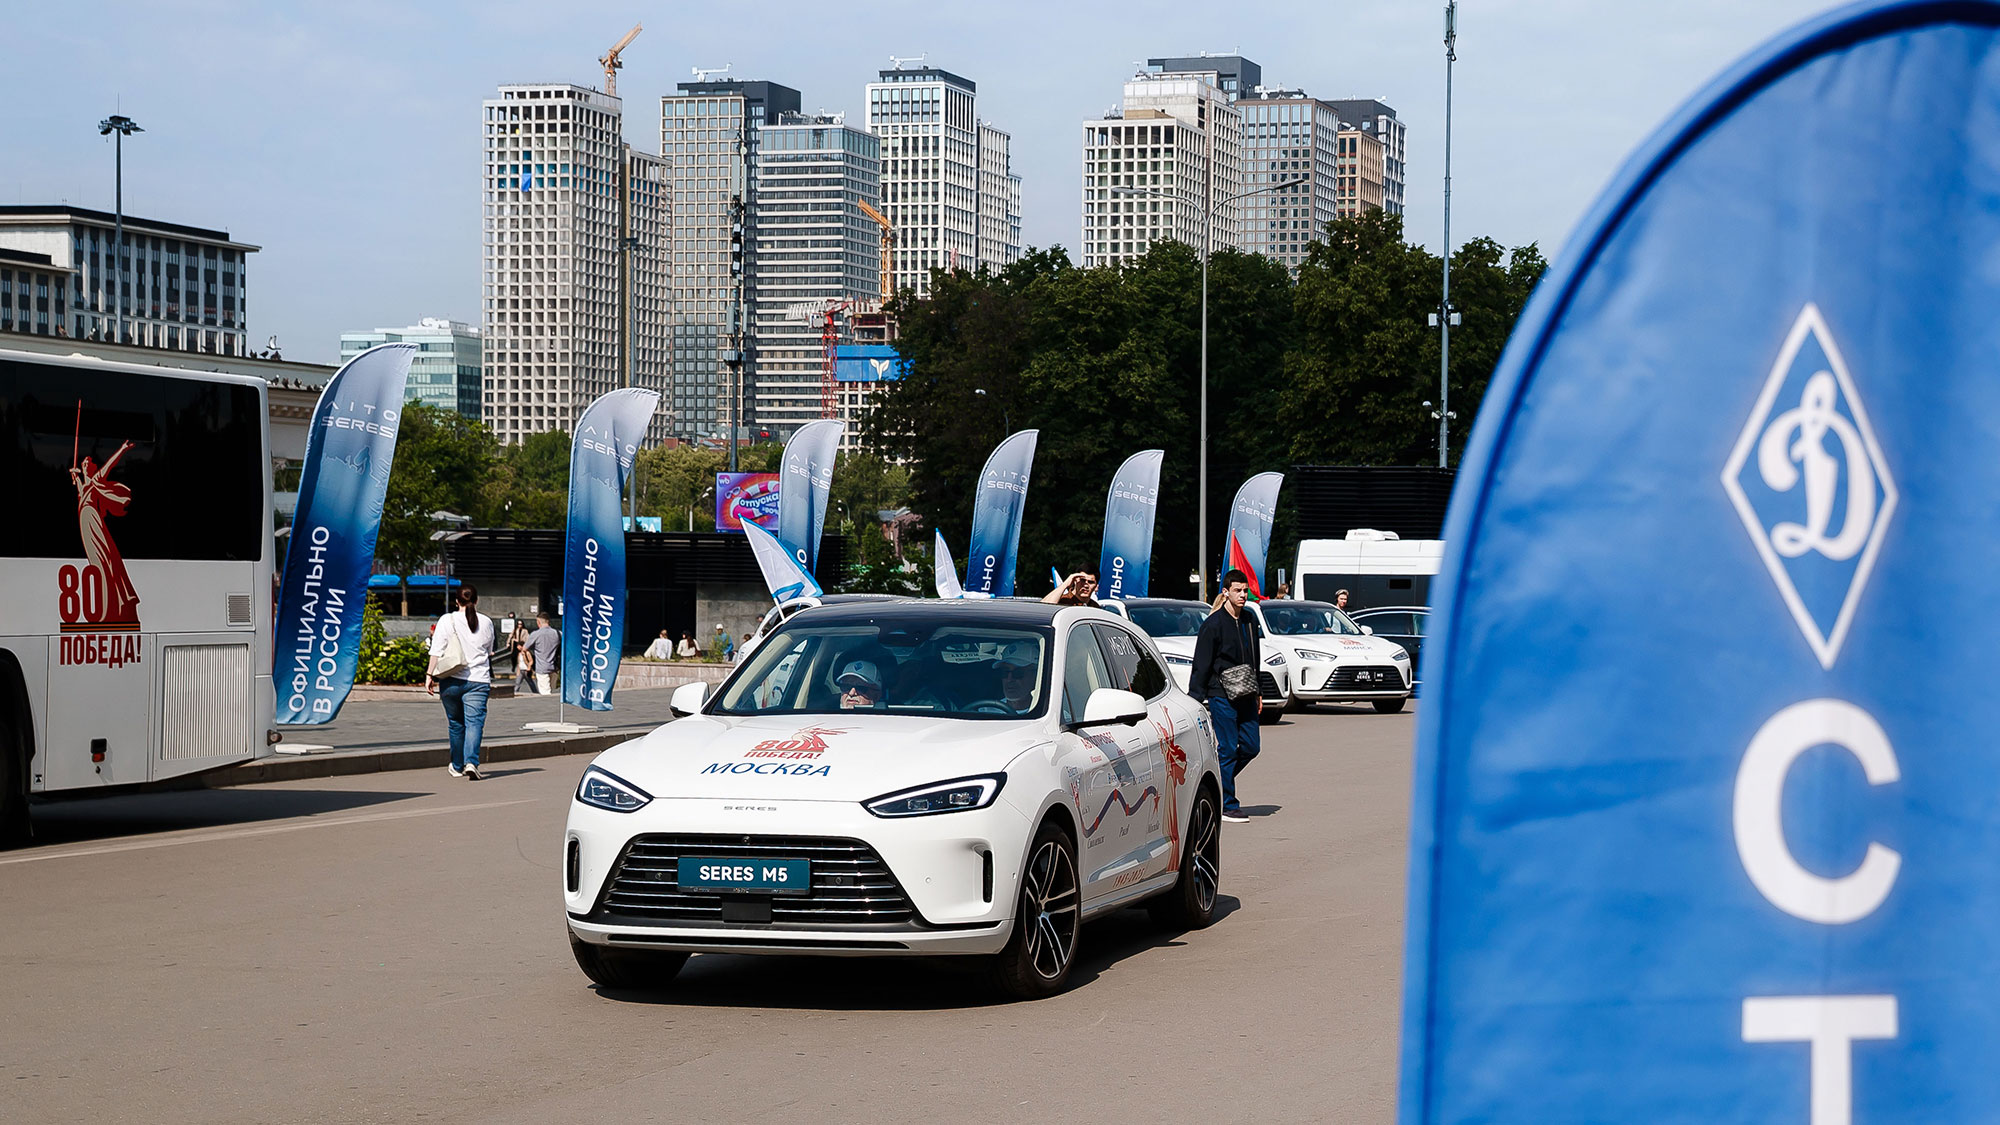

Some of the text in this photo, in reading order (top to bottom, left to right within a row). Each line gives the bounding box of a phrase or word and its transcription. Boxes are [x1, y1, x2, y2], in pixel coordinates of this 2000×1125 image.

[321, 415, 395, 439] SERES
[987, 480, 1025, 495] SERES
[1114, 490, 1155, 506] SERES
[1238, 505, 1274, 524] SERES
[58, 564, 102, 623] 80
[289, 526, 330, 713] ОФИЦИАЛЬНО
[60, 634, 142, 669] ПОБЕДА!
[313, 588, 346, 714] В РОССИИ
[588, 594, 615, 703] В РОССИИ
[754, 740, 799, 751] 80
[744, 751, 822, 760] ПОБЕДА!
[701, 762, 832, 777] МОСКВА
[699, 865, 788, 882] SERES M5
